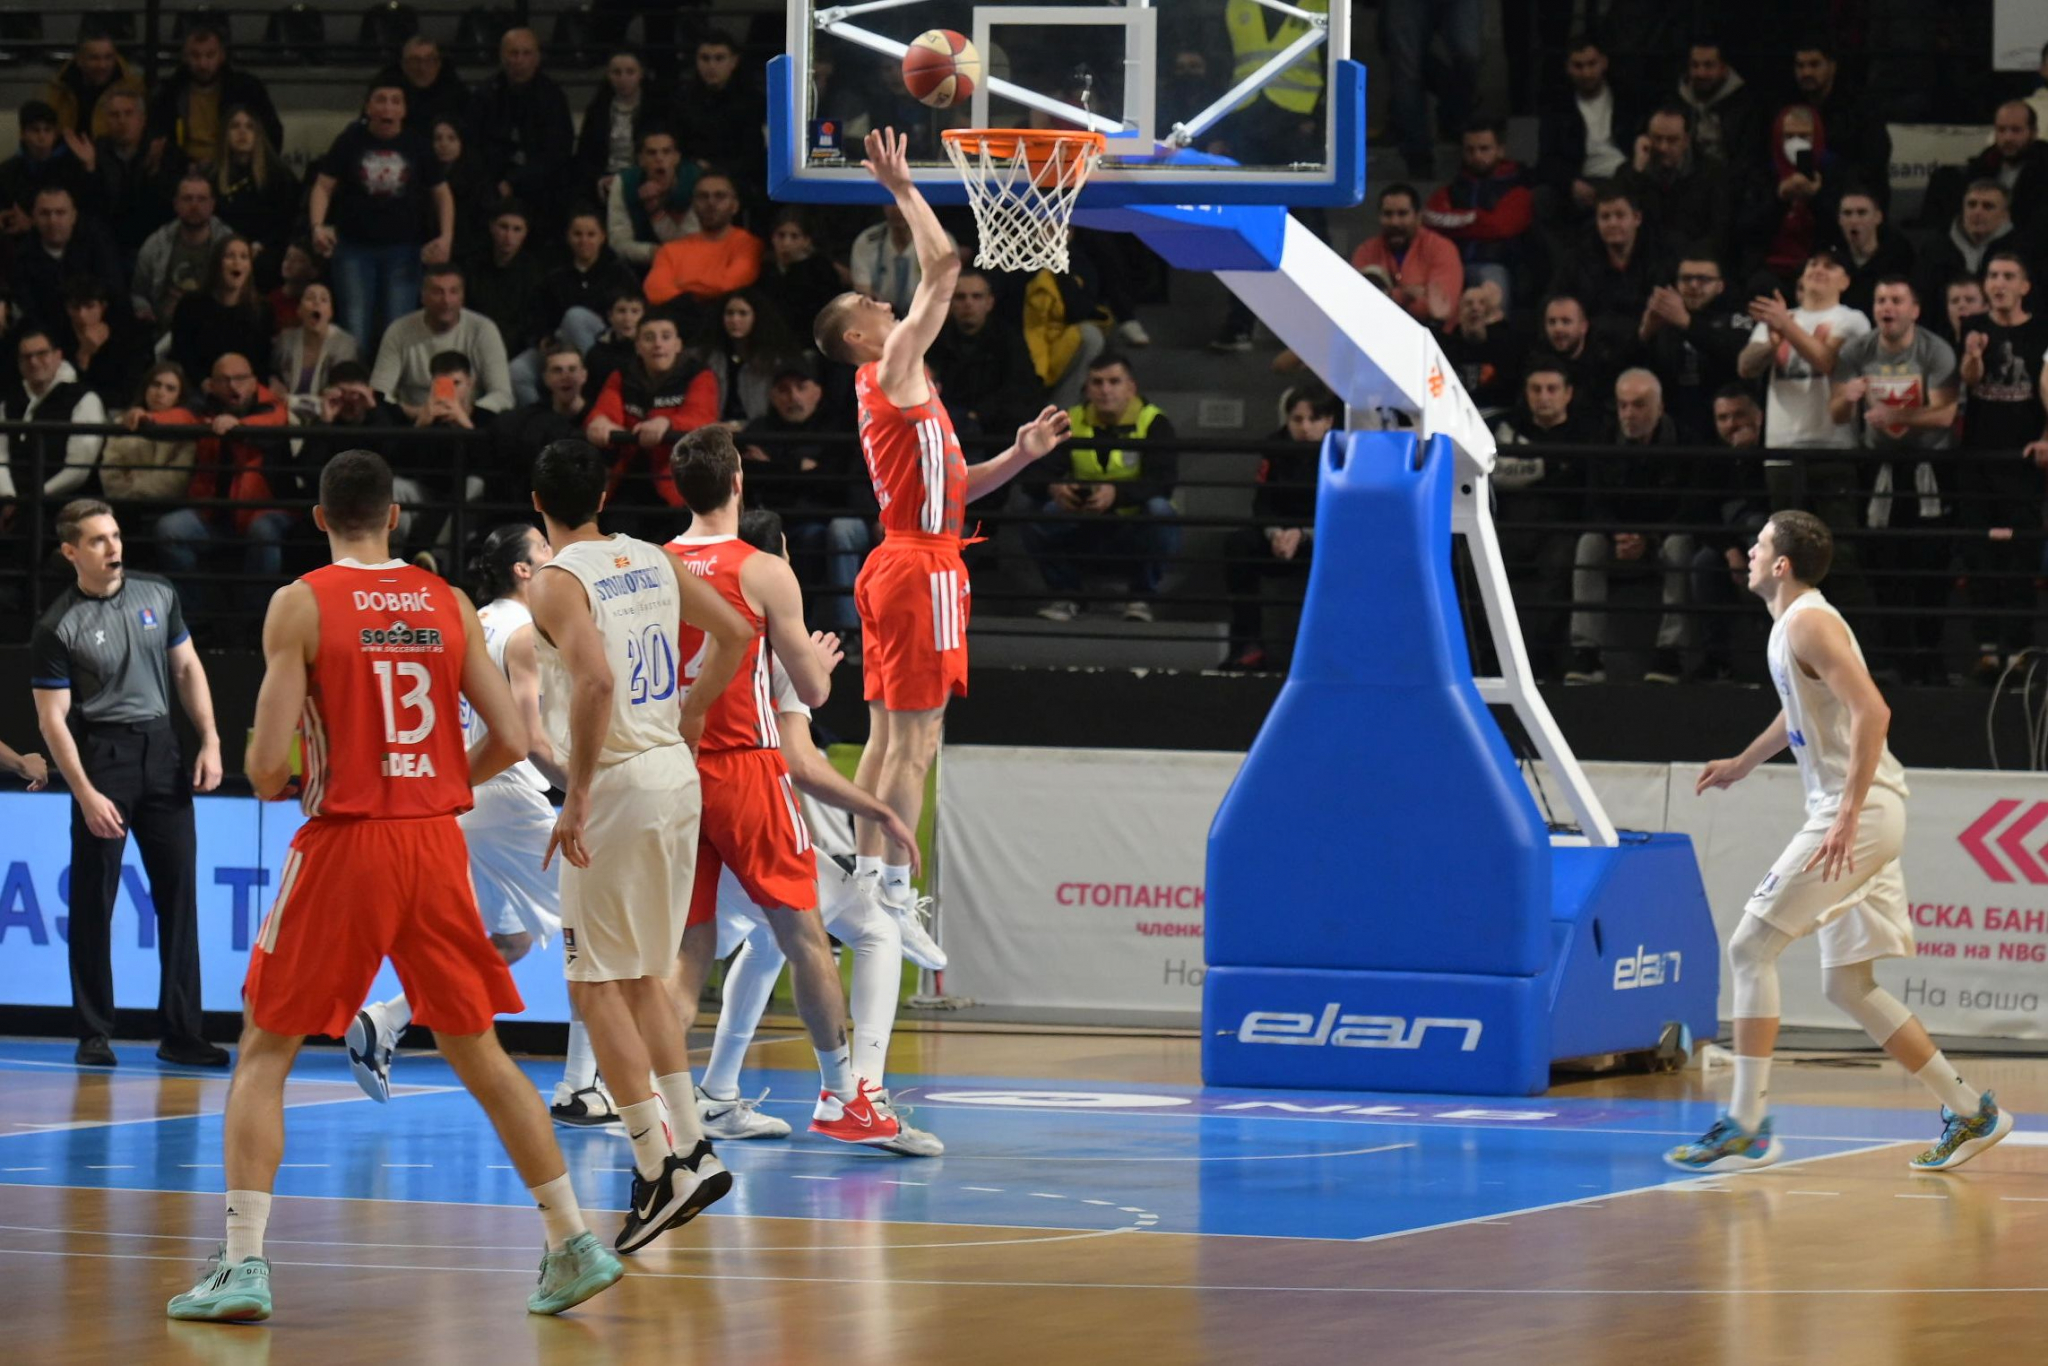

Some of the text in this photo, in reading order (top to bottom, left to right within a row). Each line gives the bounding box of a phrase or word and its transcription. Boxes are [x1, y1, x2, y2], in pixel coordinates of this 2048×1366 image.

[352, 587, 435, 612] DOBRIĆ
[628, 624, 675, 705] 20
[373, 661, 436, 744] 13
[0, 861, 156, 949] AY
[1984, 907, 2048, 934] БАН
[1136, 922, 1205, 937] членк
[1613, 944, 1681, 990] elan
[1998, 943, 2046, 963] NBG
[1238, 1003, 1482, 1051] elan
